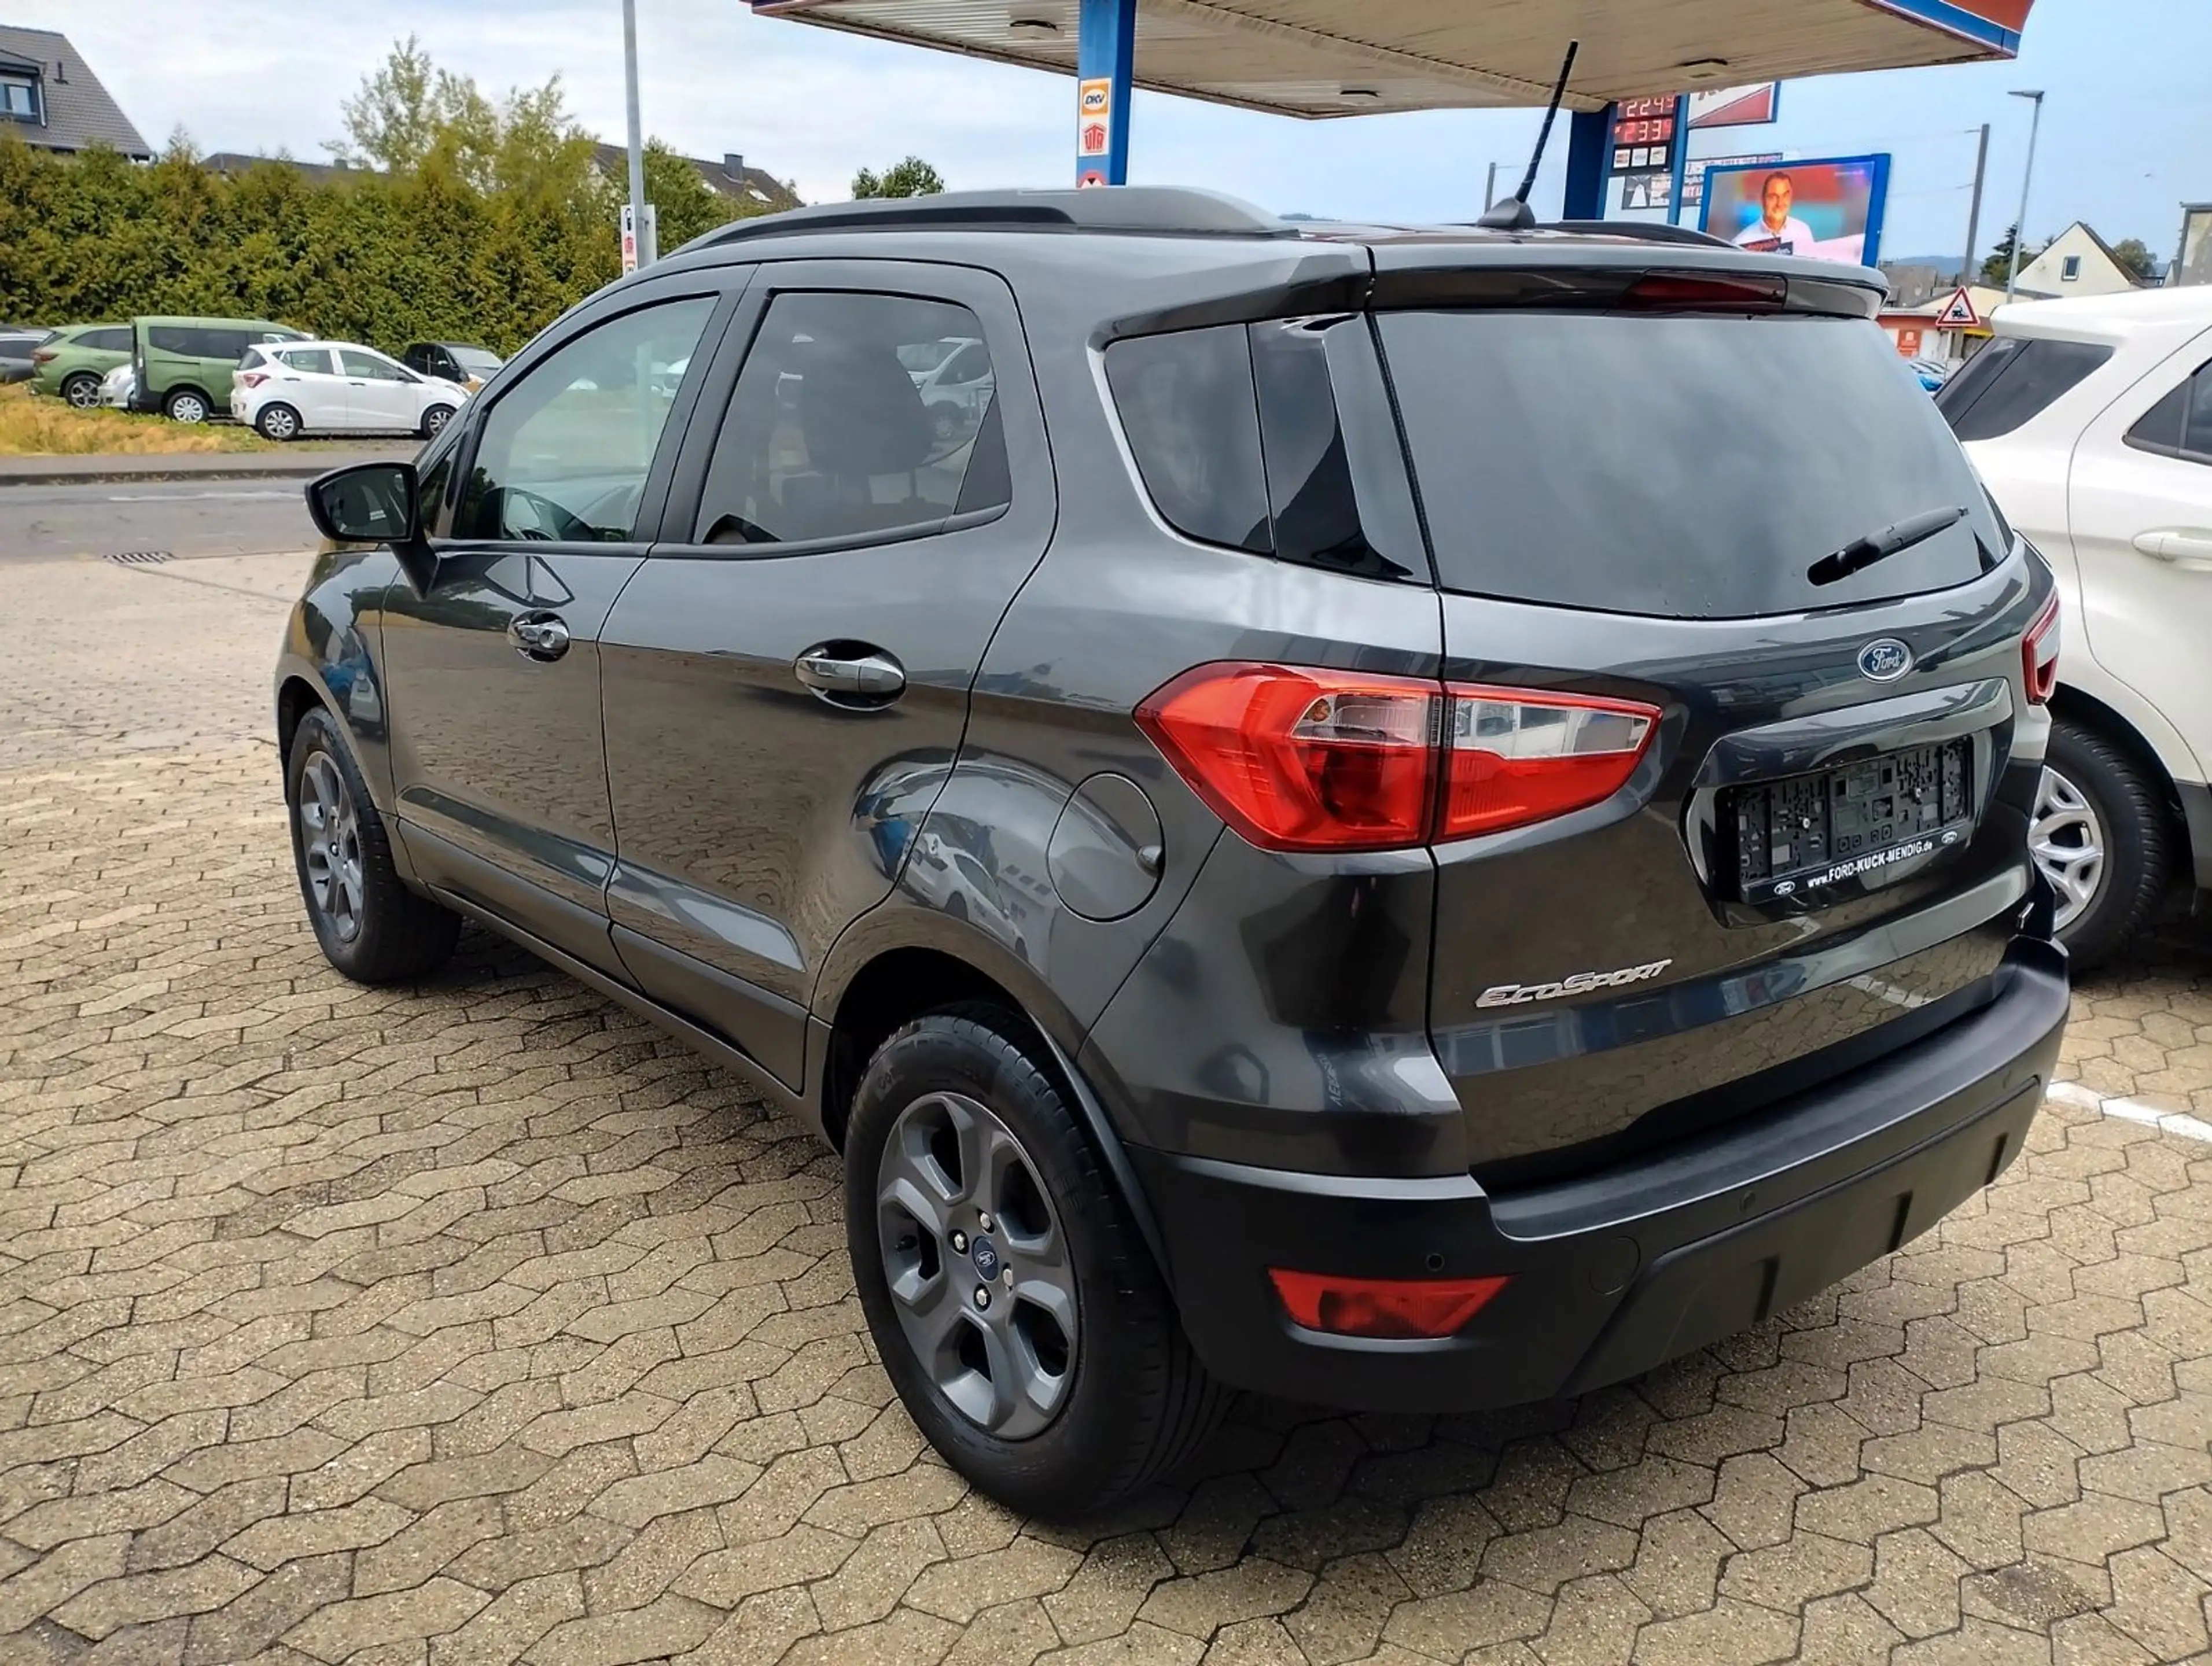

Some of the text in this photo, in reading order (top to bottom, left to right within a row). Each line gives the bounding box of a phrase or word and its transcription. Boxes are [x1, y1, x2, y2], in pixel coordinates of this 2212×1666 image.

[1085, 94, 1105, 105] DKV
[1084, 124, 1105, 150] UTA
[1872, 648, 1901, 672] Ford
